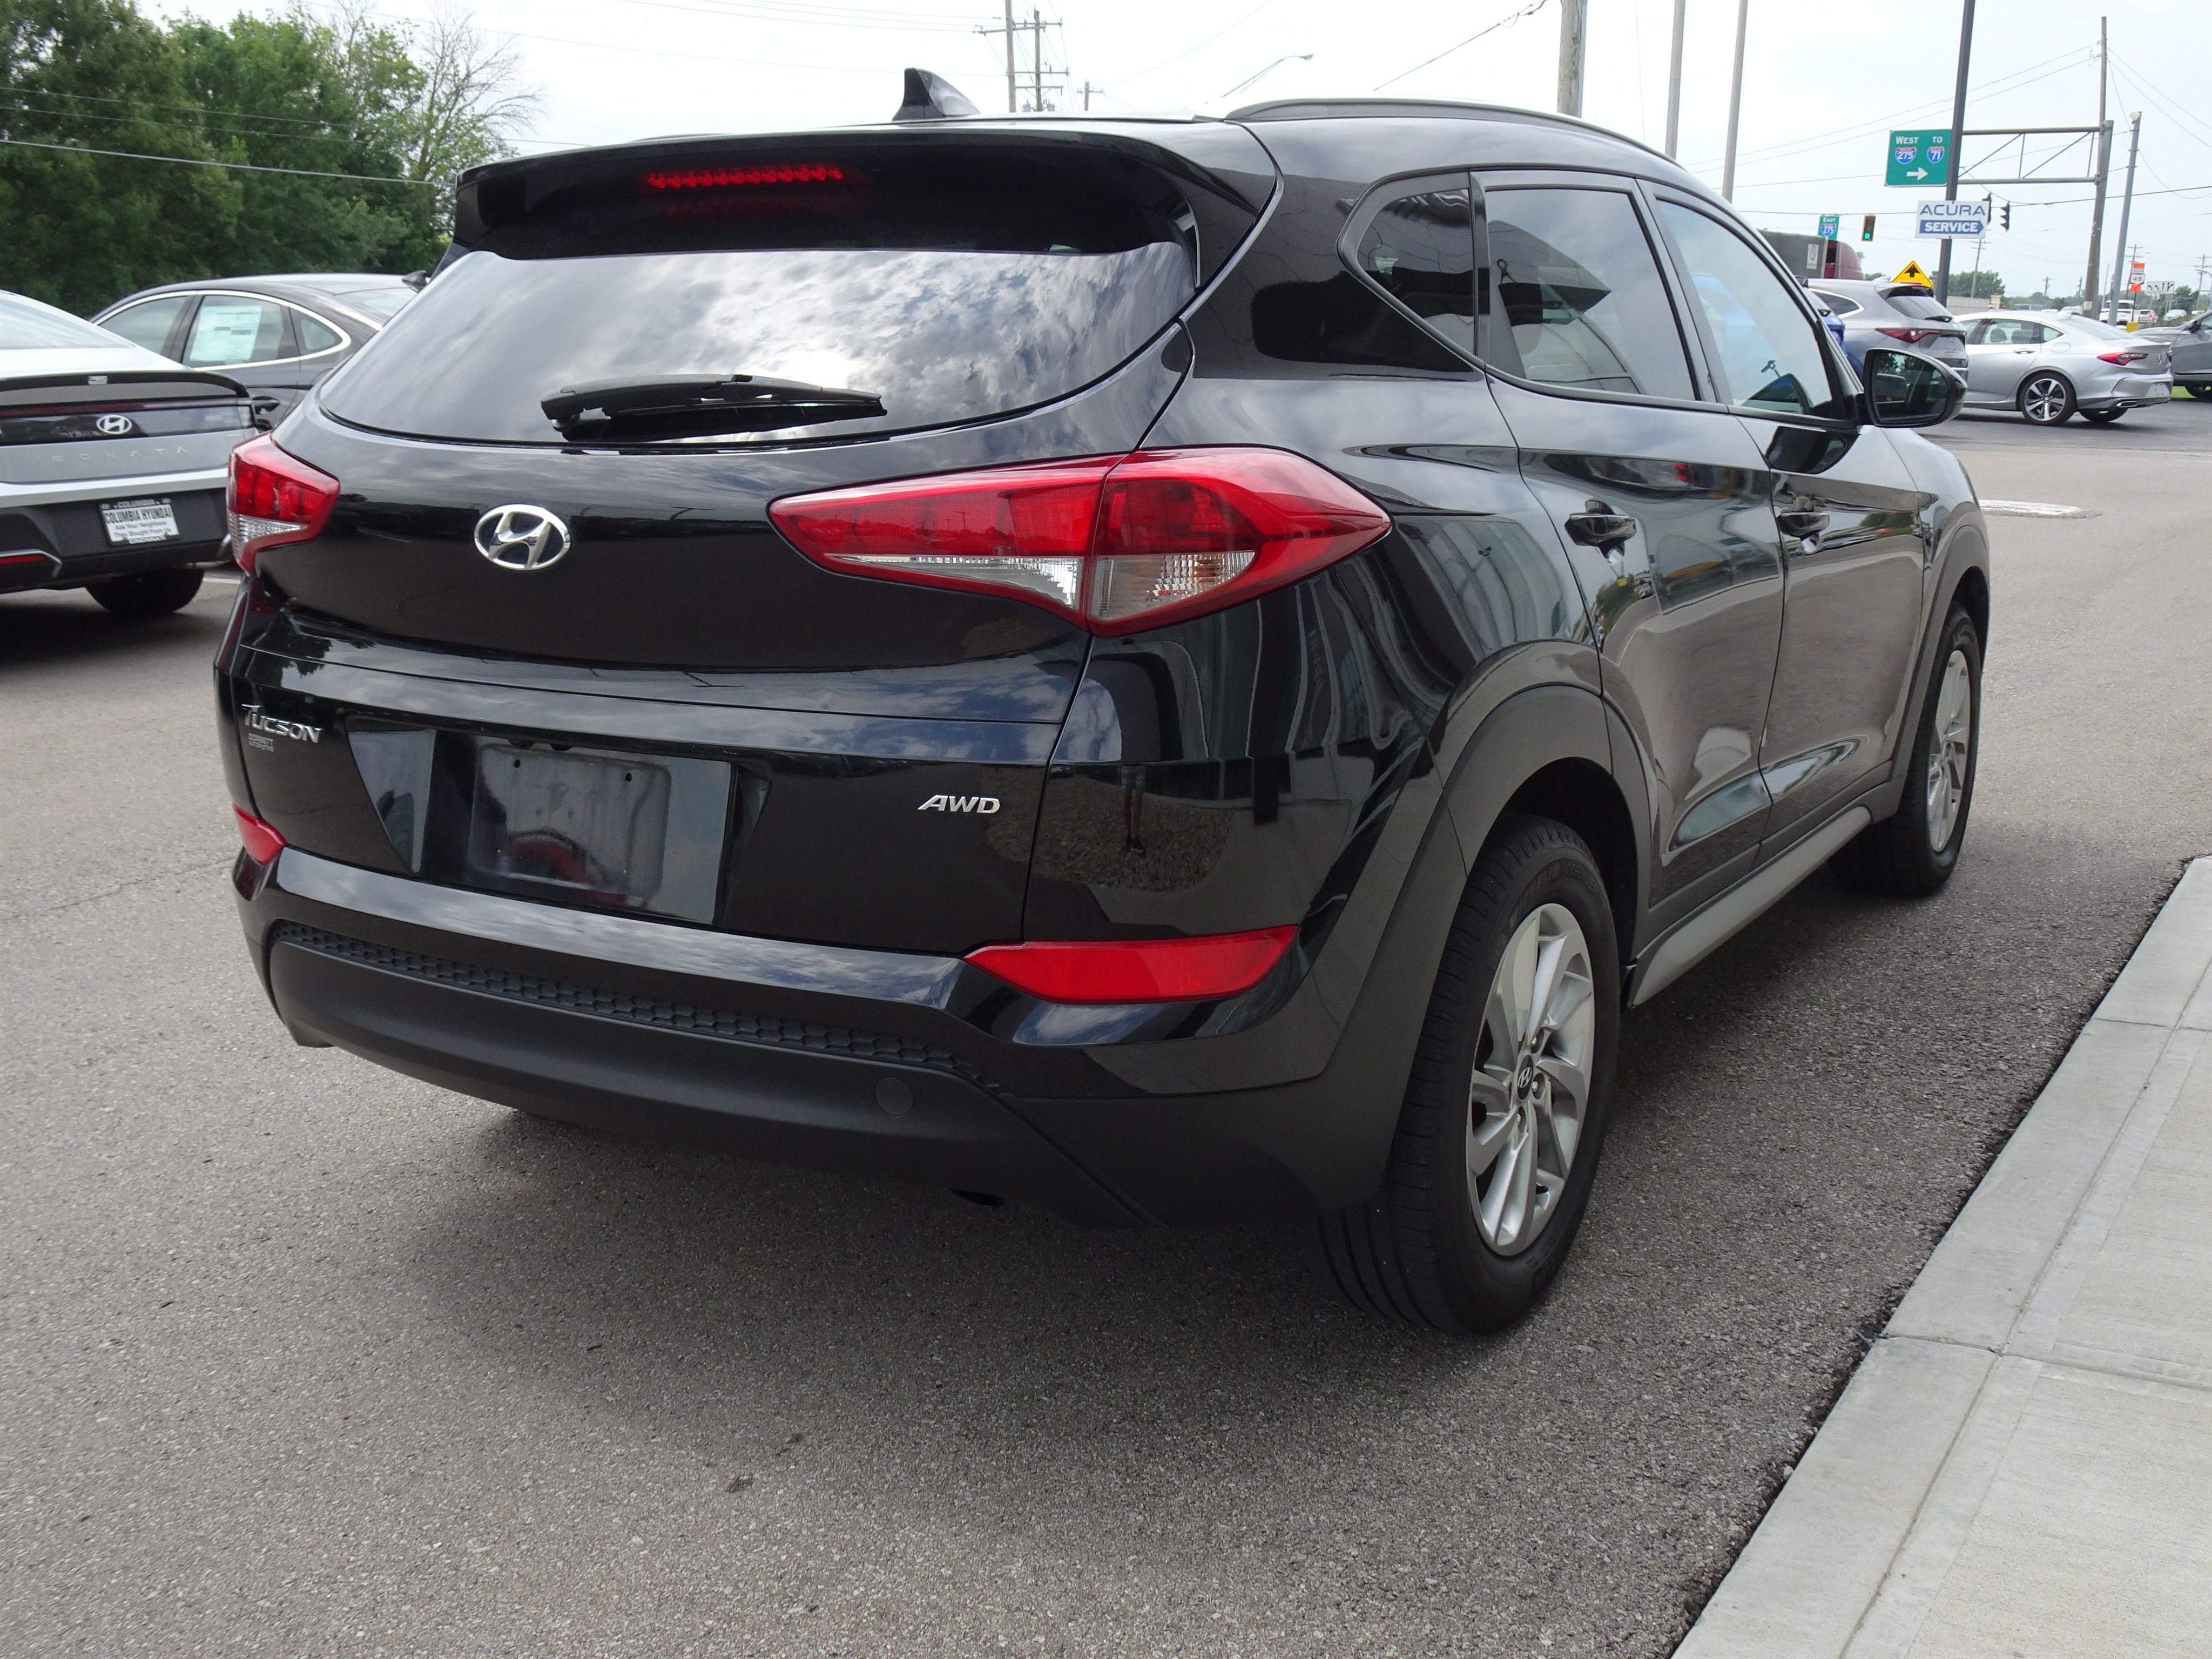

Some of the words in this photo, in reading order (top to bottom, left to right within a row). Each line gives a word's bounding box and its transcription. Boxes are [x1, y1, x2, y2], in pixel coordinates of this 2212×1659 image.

[1896, 136, 1919, 144] WEST
[1897, 151, 1913, 159] 275
[1931, 151, 1941, 160] 71
[1919, 205, 1986, 215] ACURA
[1924, 222, 1979, 232] SERVICE
[104, 510, 141, 523] COLUMBIA
[141, 507, 172, 521] HYUNDAI
[241, 704, 322, 744] TUCSON
[918, 794, 1000, 814] AWD
